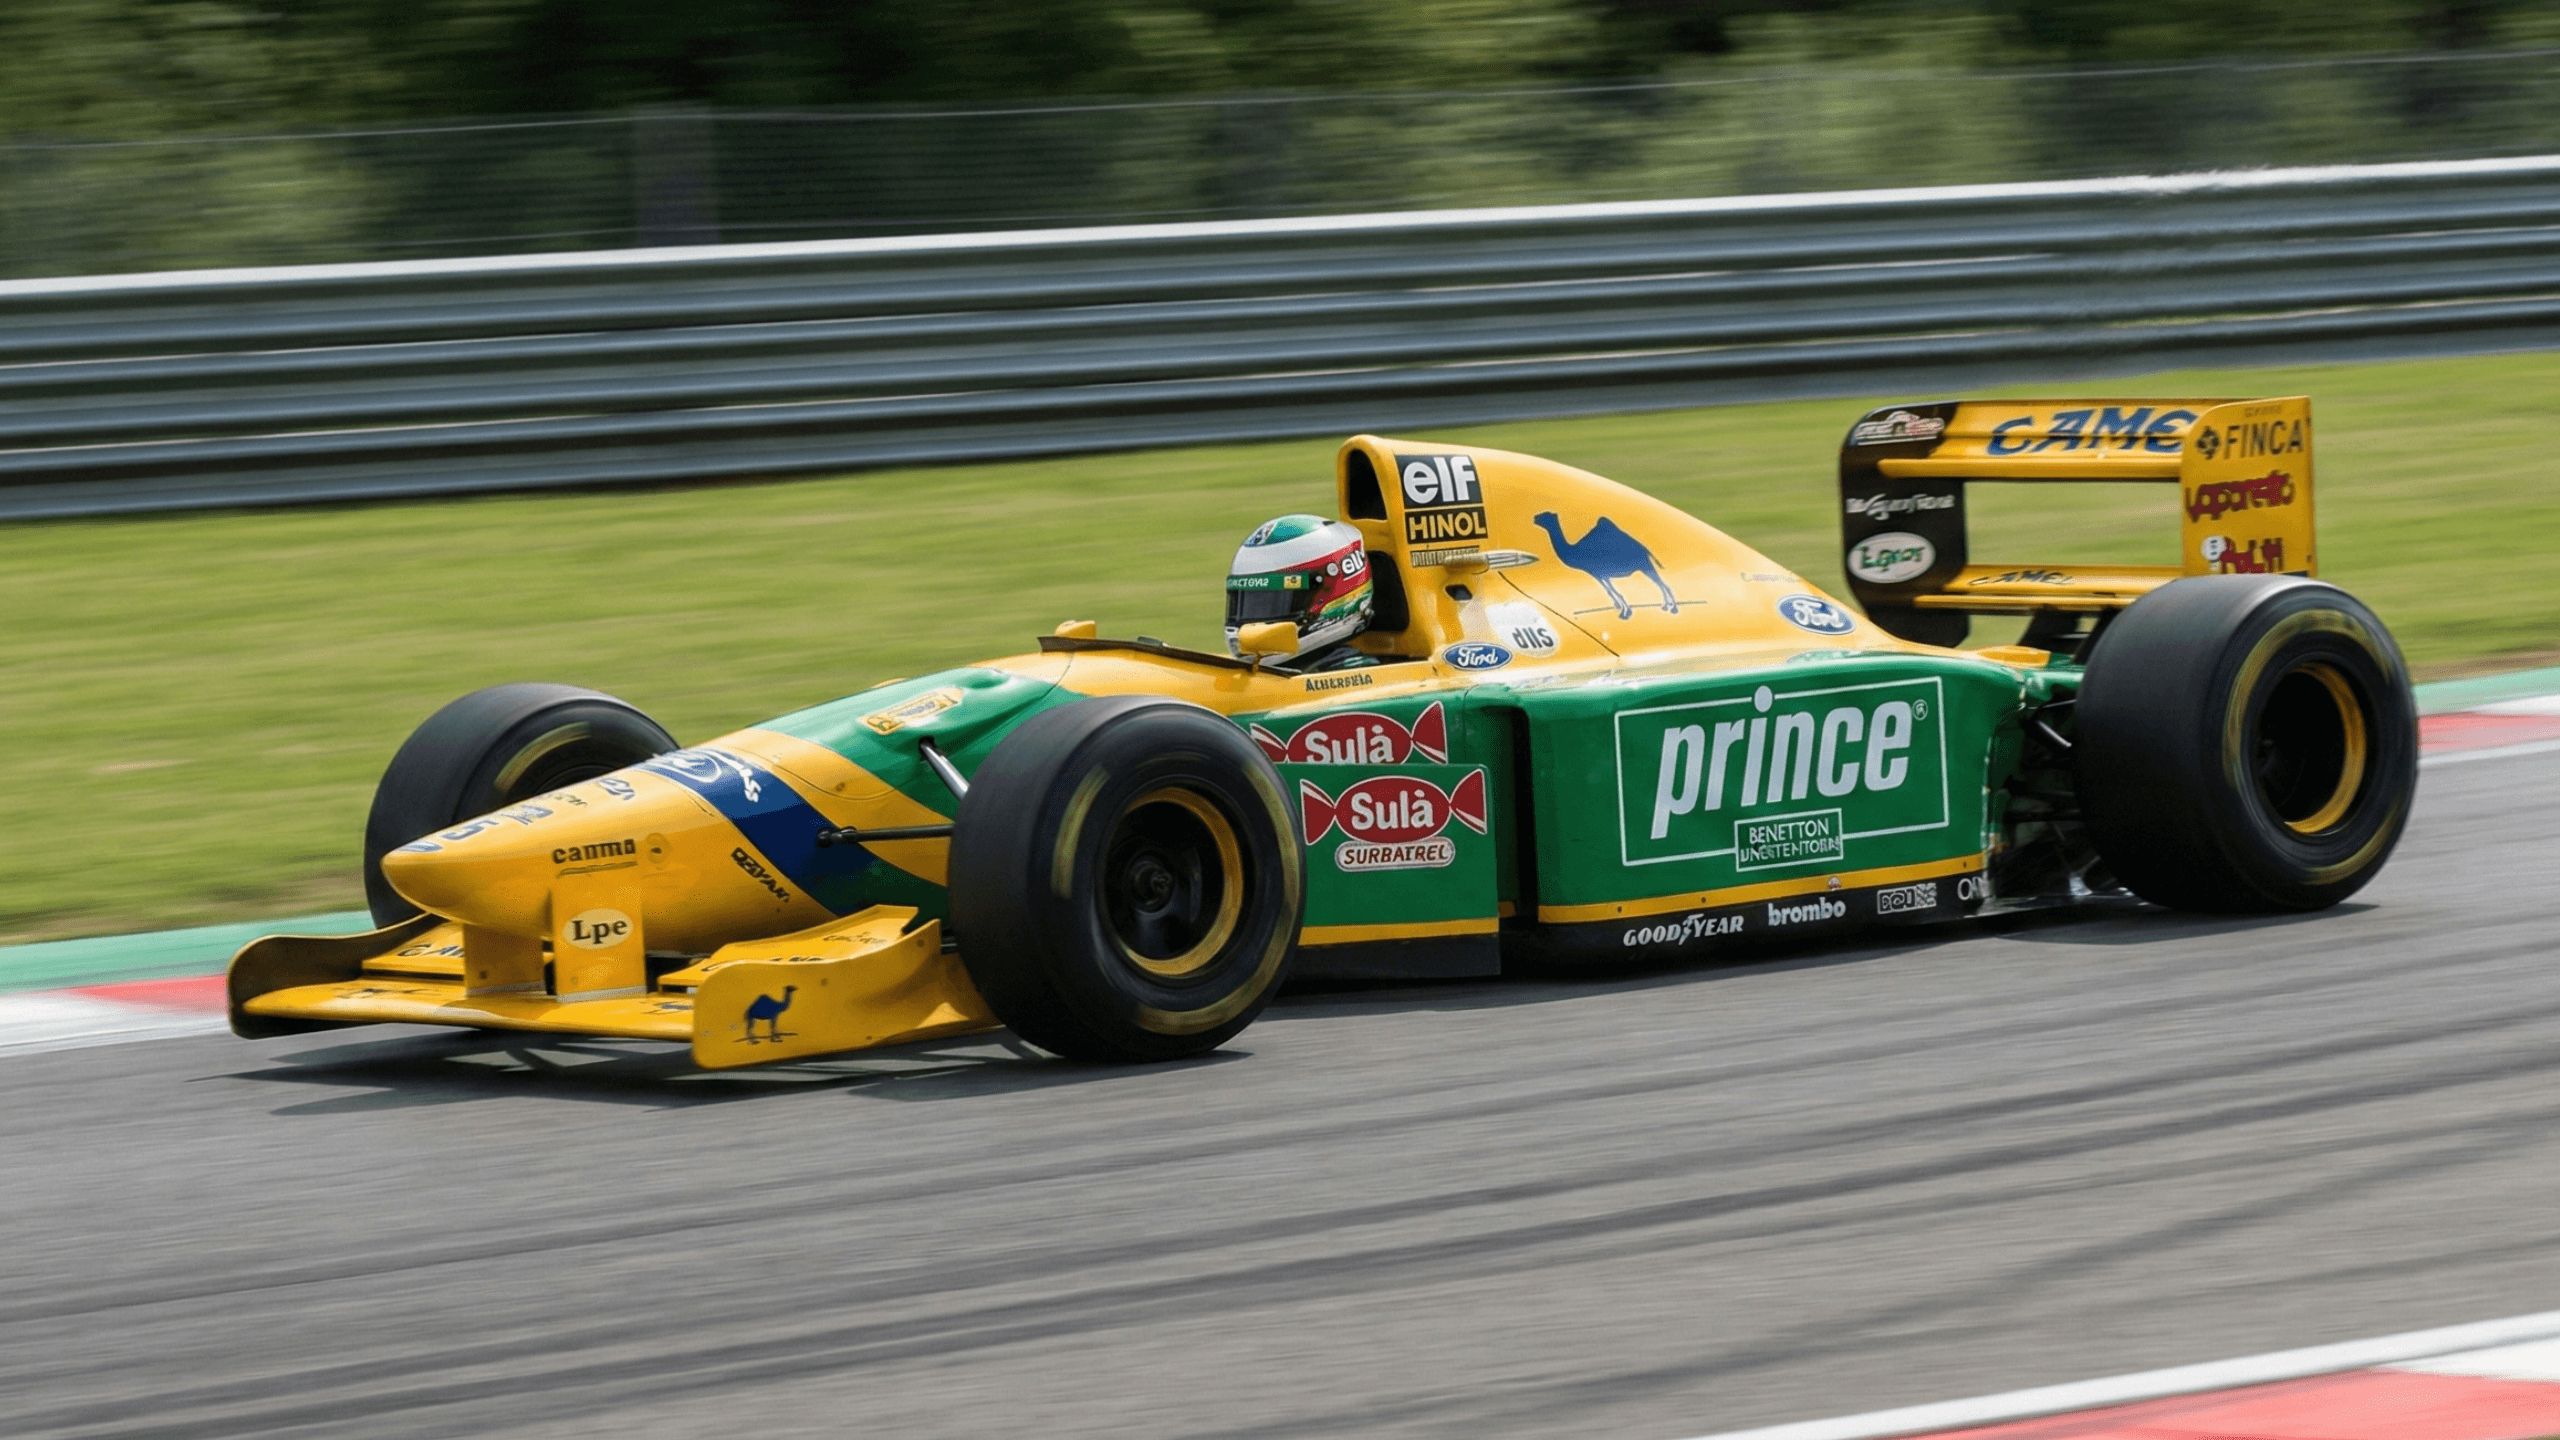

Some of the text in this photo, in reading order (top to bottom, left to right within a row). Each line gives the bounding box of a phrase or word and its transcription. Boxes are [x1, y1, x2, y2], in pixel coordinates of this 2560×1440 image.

[2223, 418, 2304, 459] FINCA
[1403, 456, 1476, 504] elf
[1408, 512, 1487, 540] HINOL
[1351, 789, 1435, 831] Sulà
[1749, 817, 1830, 845] BENETTON
[1768, 897, 1846, 927] brombo
[571, 919, 628, 945] Lpe
[1623, 914, 1745, 947] GOODYEAR
